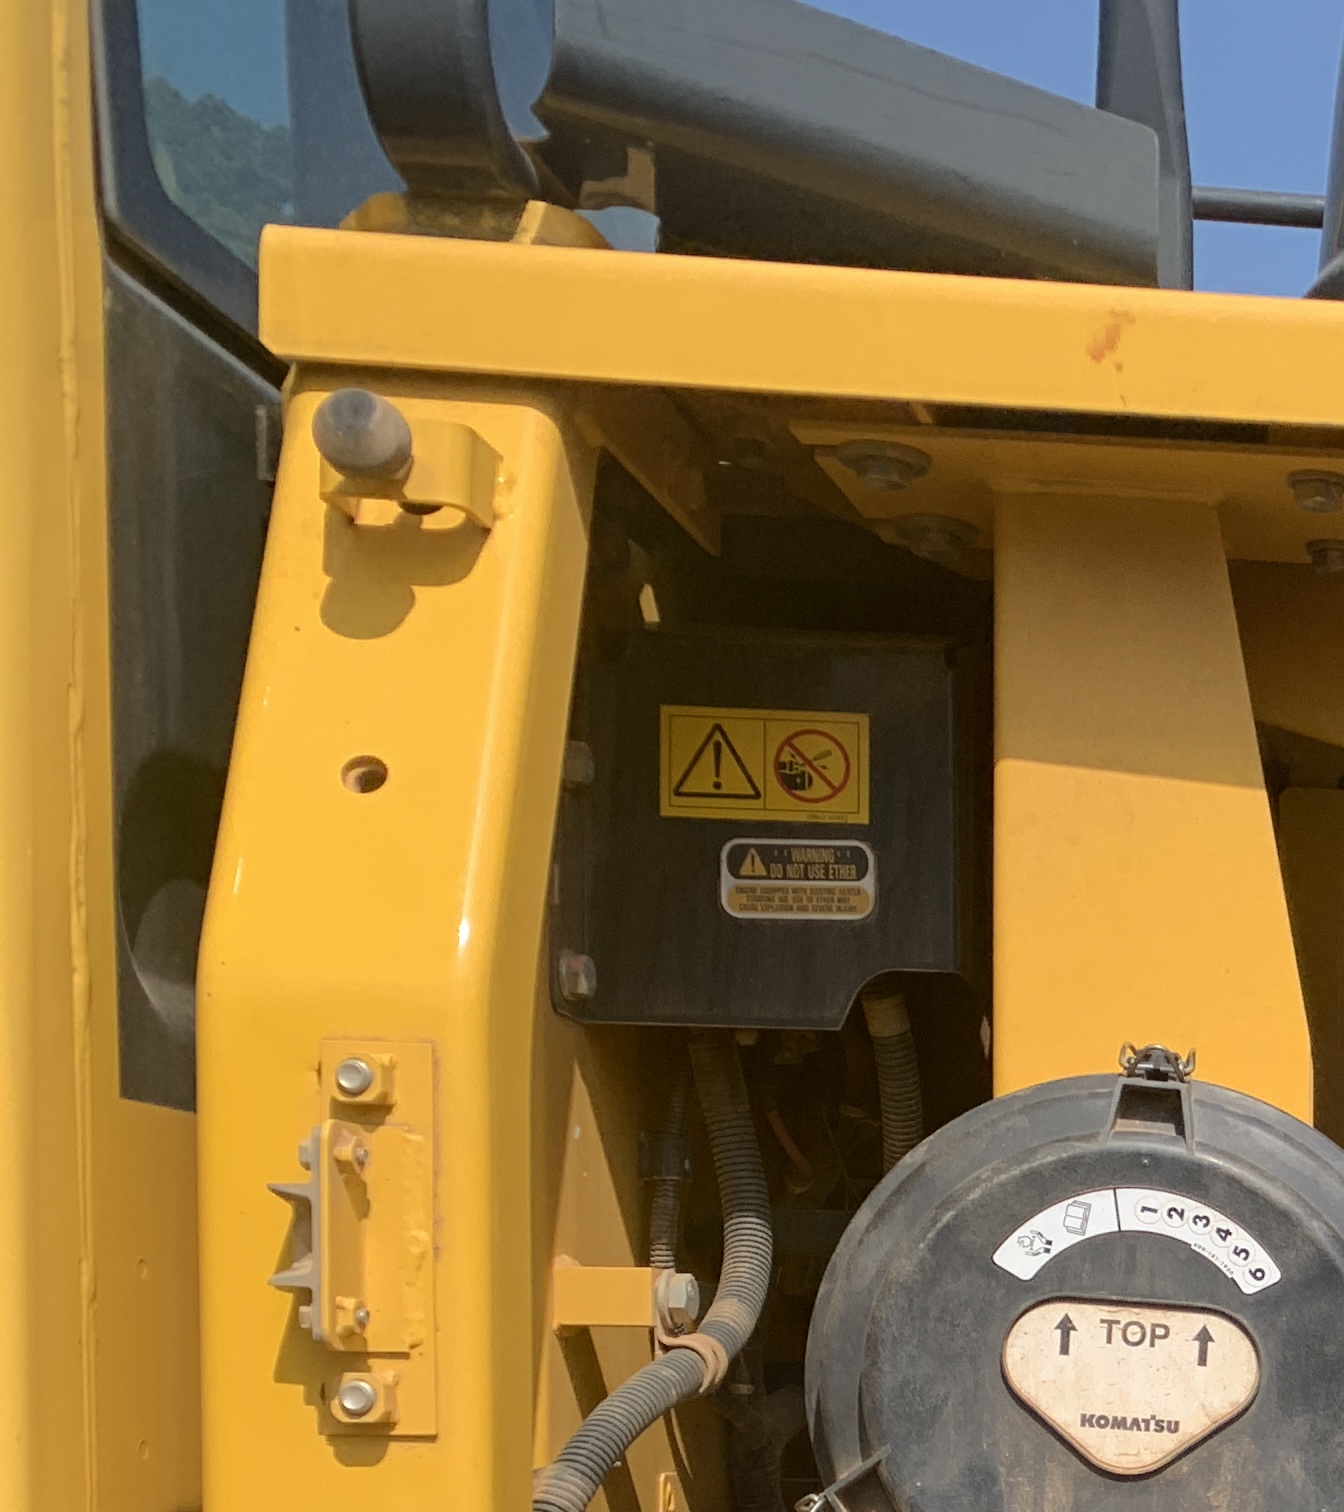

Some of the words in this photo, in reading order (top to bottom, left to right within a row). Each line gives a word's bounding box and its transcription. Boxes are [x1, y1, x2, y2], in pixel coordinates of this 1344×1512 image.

[790, 848, 835, 863] WARNING
[770, 863, 783, 878] DO
[786, 863, 805, 879] NOT
[807, 863, 825, 879] USE
[828, 864, 857, 880] ETHER
[1140, 1205, 1158, 1214] 1
[1167, 1206, 1185, 1221] 2
[1192, 1214, 1210, 1228] 3
[1215, 1226, 1233, 1242] 4
[1233, 1245, 1250, 1261] 5
[1248, 1267, 1266, 1281] 6
[1100, 1318, 1170, 1348] TOP
[1080, 1412, 1180, 1434] KOMATSU
